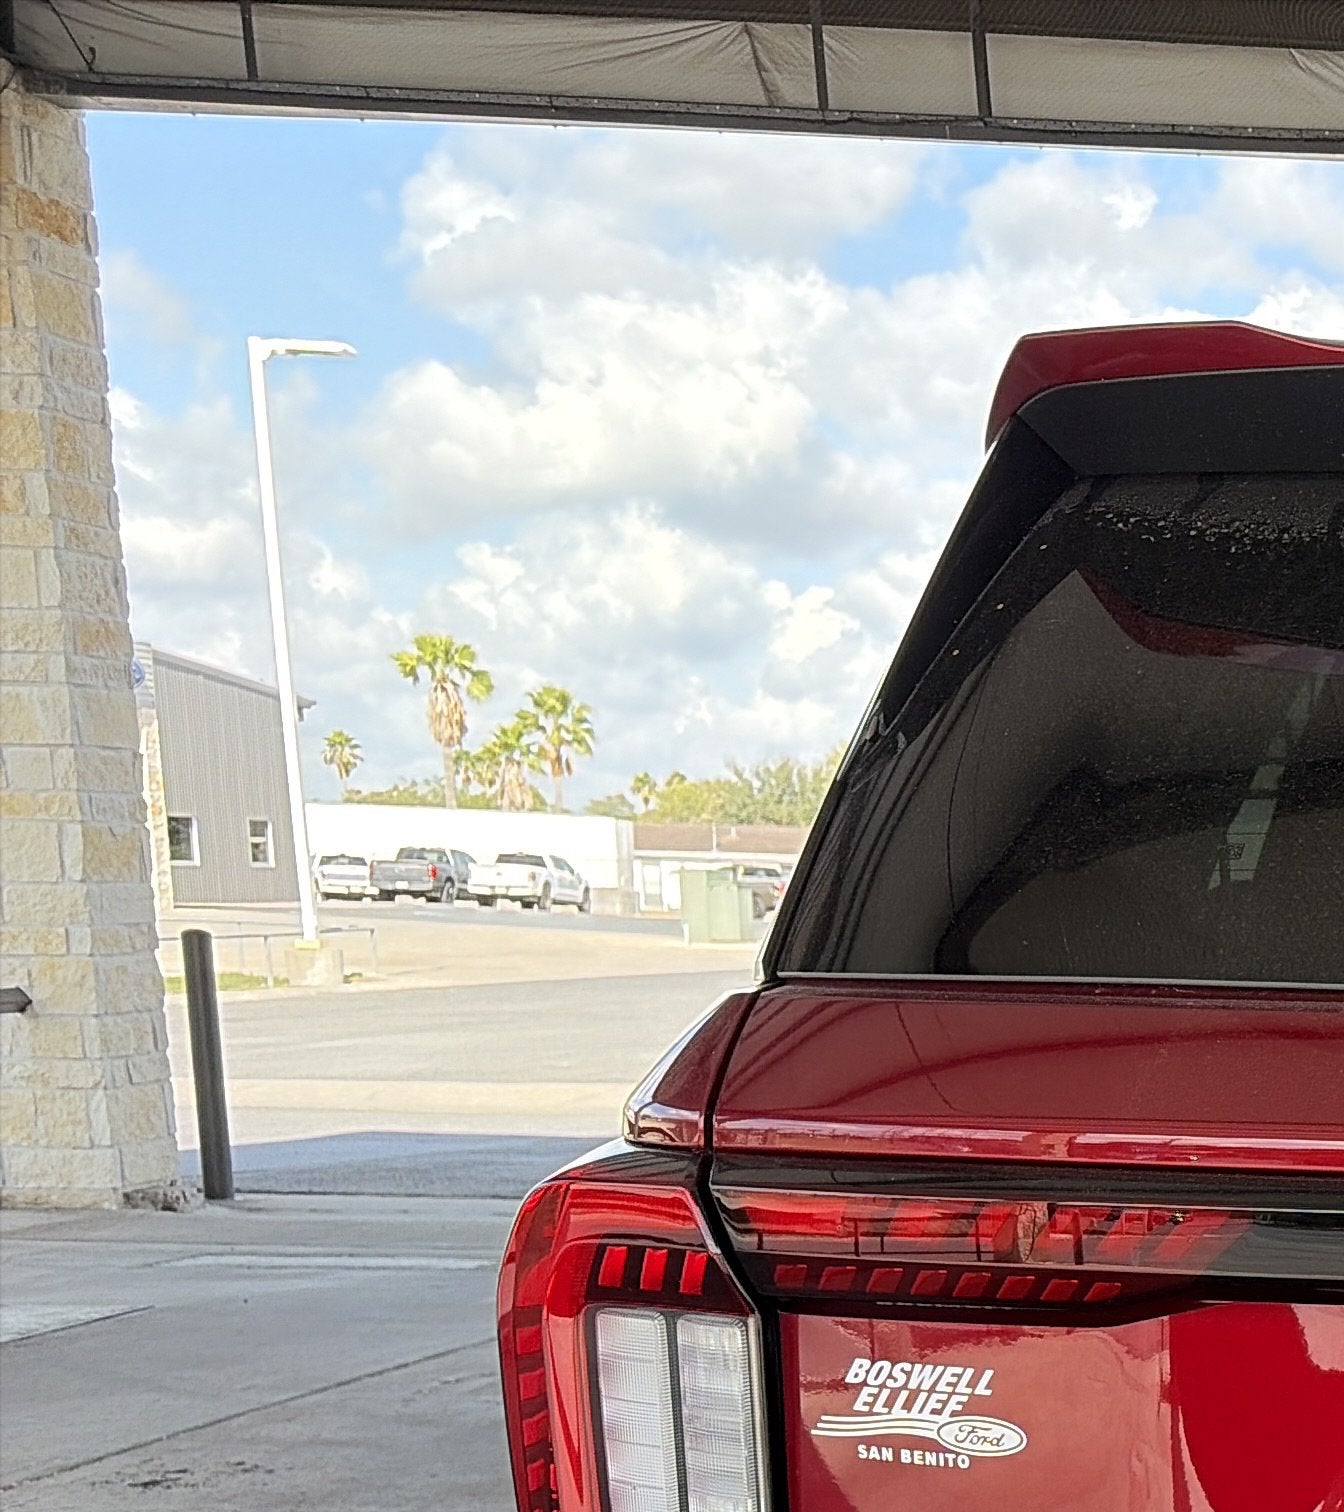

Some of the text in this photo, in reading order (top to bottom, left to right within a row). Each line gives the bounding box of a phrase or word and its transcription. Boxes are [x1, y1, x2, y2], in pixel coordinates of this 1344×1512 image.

[845, 1358, 995, 1396] BOSWELL
[854, 1387, 968, 1417] ELLIFF
[955, 1424, 1005, 1446] Ford
[857, 1444, 970, 1469] SAN BENITO
